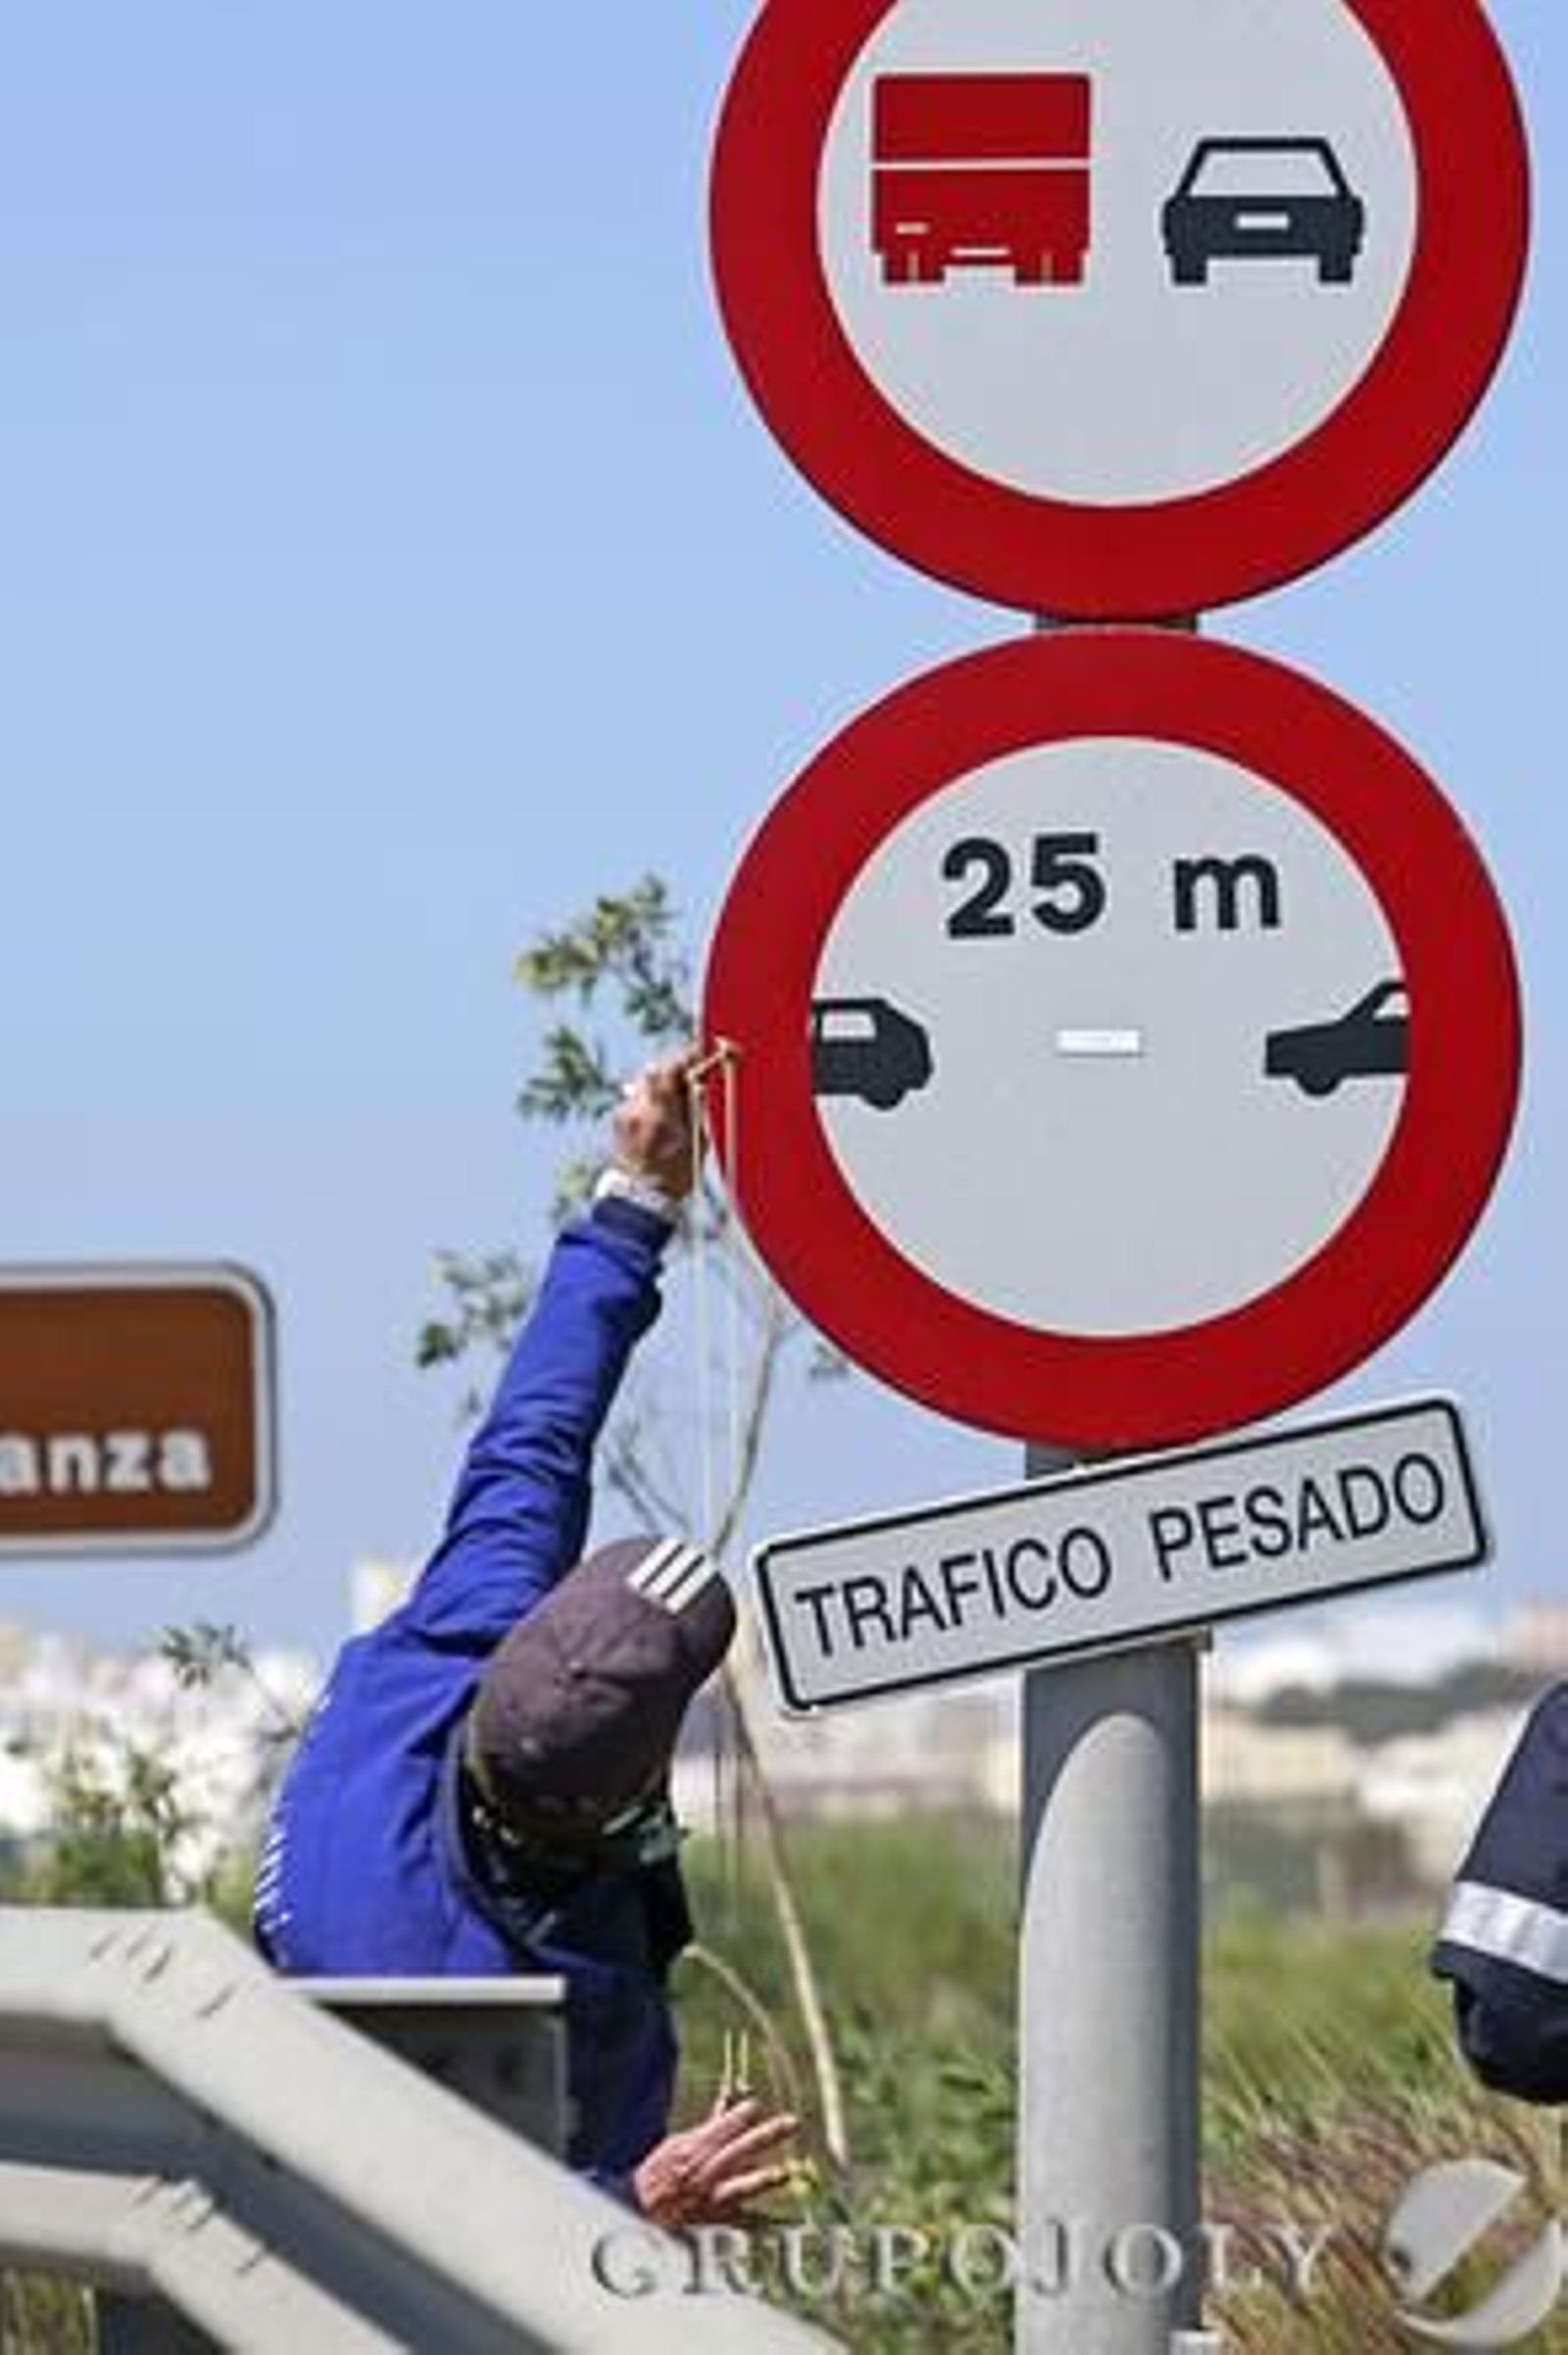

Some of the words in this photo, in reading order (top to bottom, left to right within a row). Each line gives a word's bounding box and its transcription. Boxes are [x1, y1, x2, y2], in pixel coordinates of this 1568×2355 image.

[943, 833, 1106, 939] 25
[1174, 855, 1281, 931] m
[794, 1528, 1111, 1657] TRAFICO
[1151, 1452, 1445, 1581] PESADO
